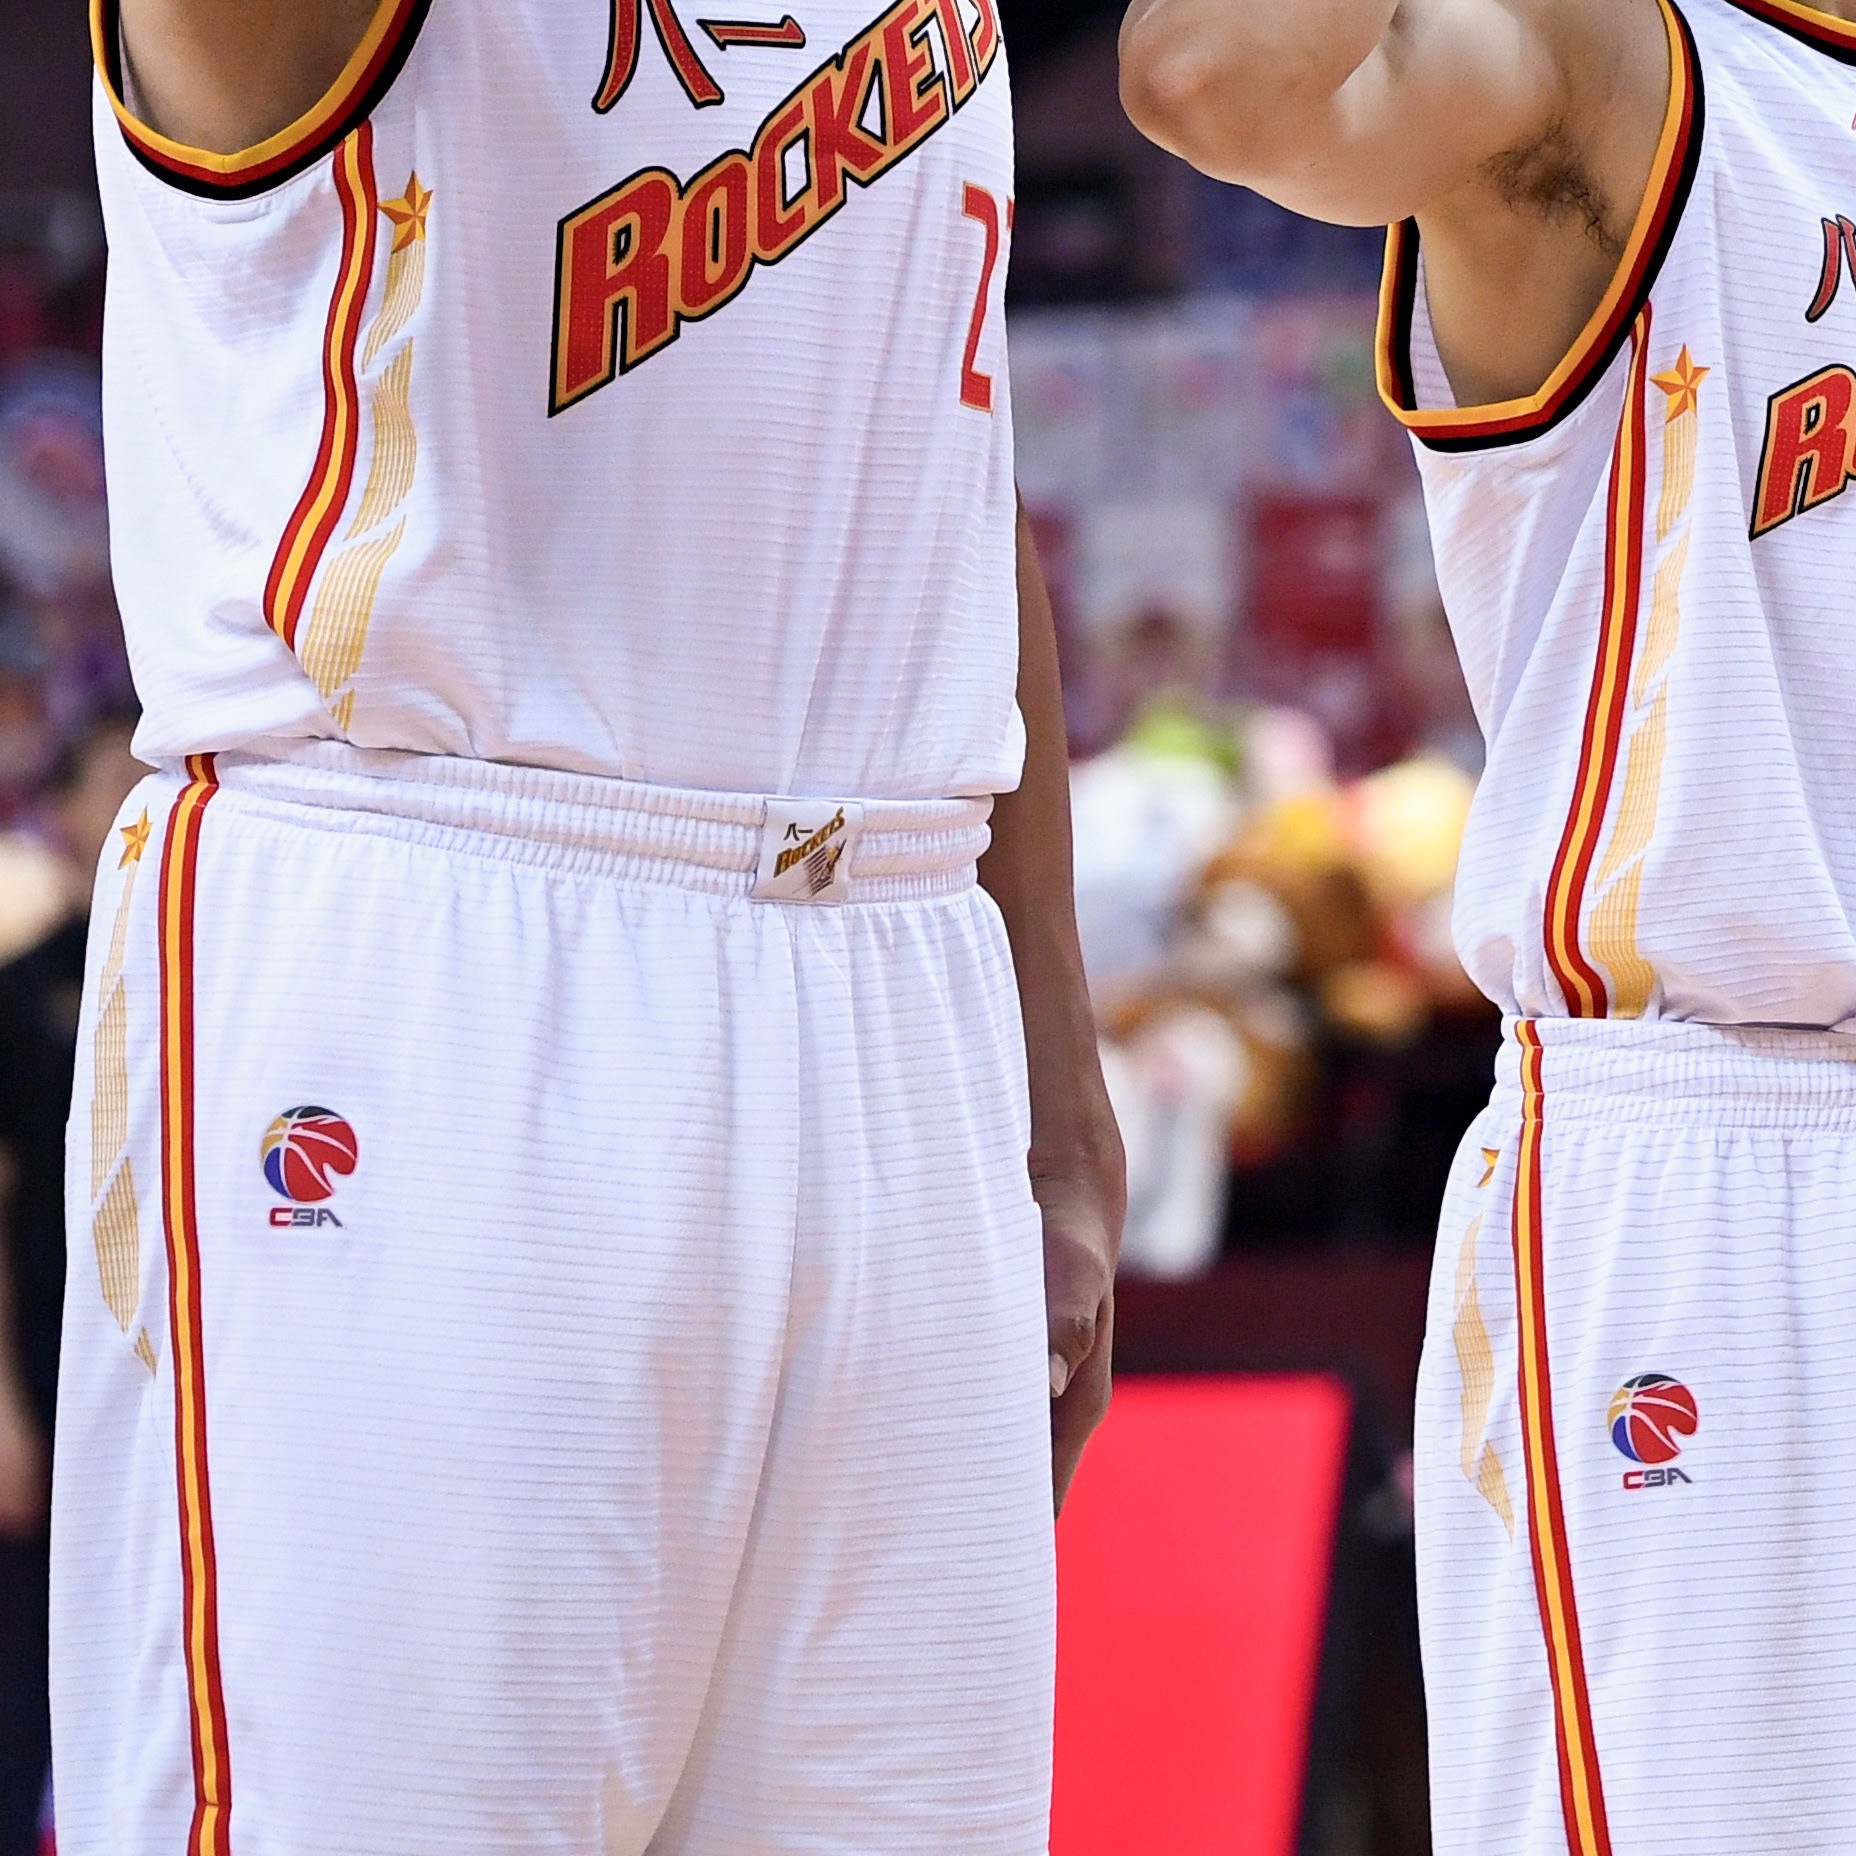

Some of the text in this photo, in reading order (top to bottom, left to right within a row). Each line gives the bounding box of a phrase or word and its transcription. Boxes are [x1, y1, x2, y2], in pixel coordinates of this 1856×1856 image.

[782, 822, 814, 842] 八一
[269, 1207, 345, 1228] CBA
[1622, 1467, 1694, 1490] CBA
